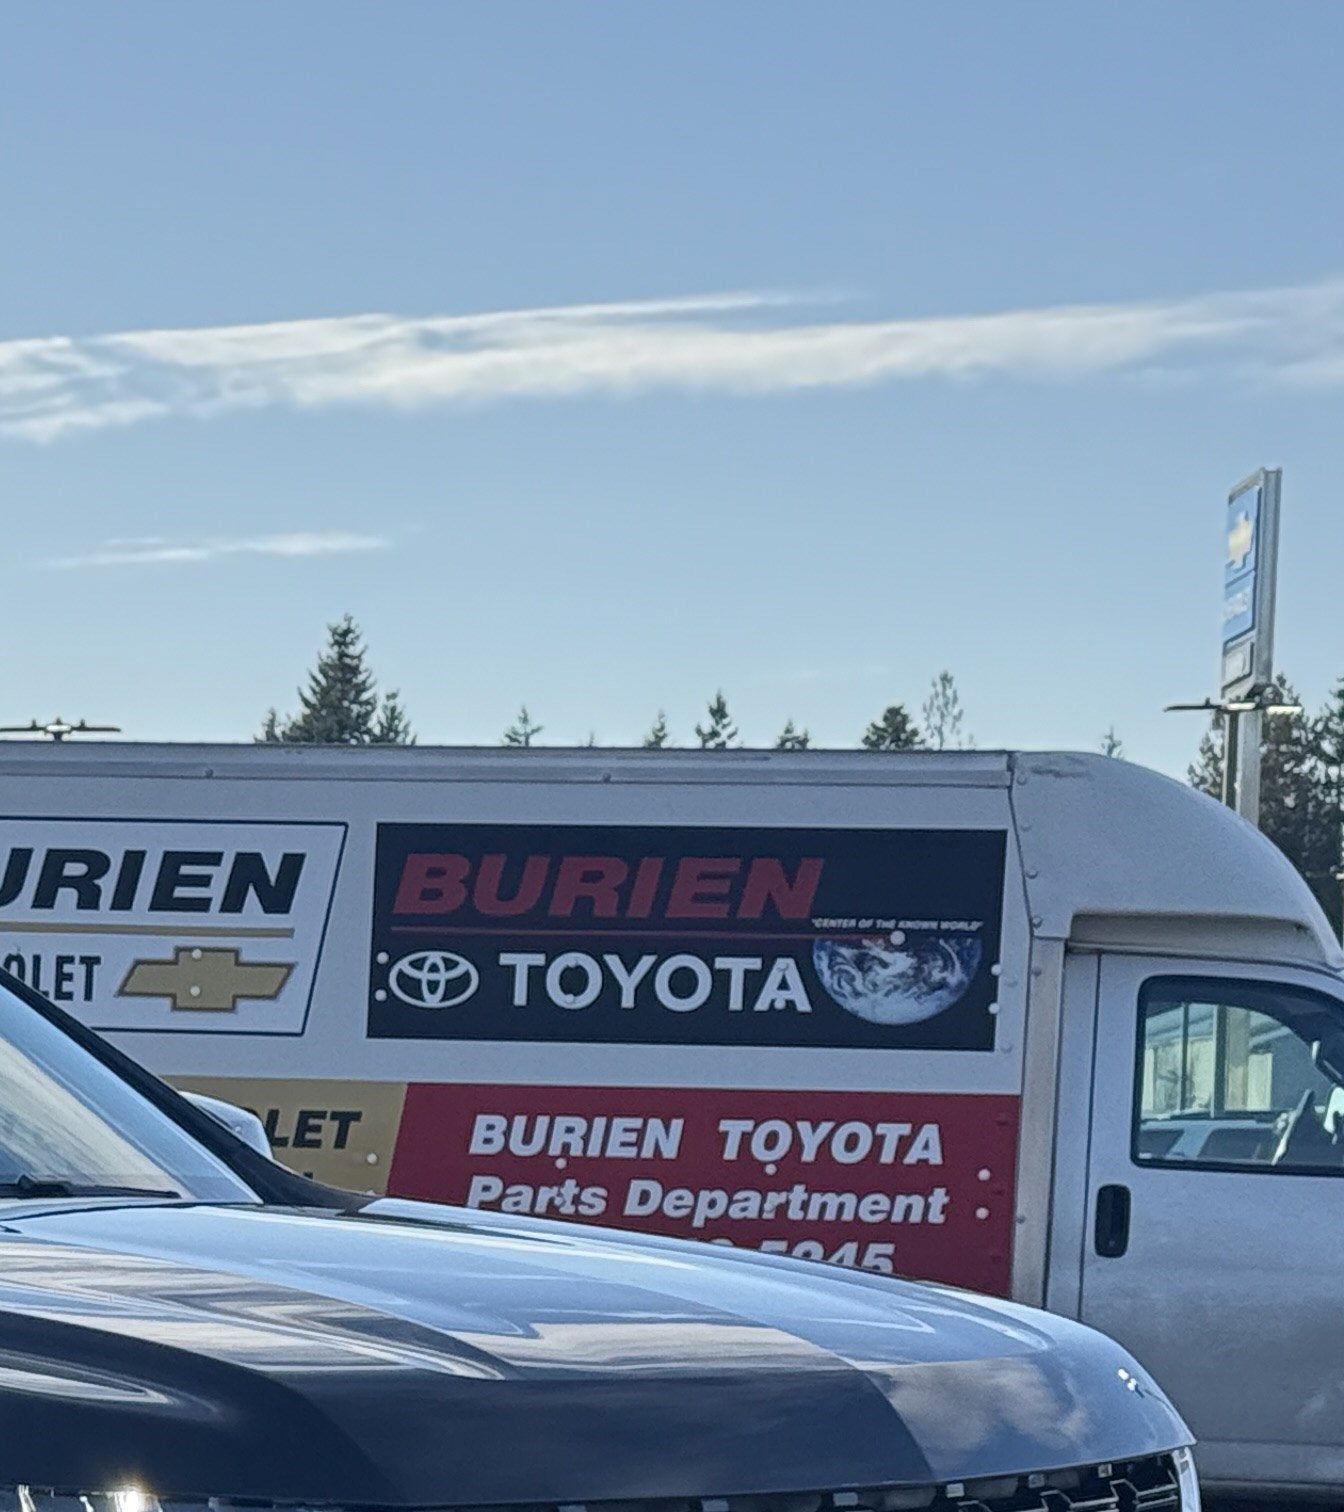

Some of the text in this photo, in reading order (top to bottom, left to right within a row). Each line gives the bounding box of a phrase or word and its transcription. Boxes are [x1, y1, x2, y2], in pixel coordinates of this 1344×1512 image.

[390, 852, 826, 922] BURIEN
[858, 918, 874, 929] OF
[875, 919, 897, 930] THE
[500, 953, 812, 1016] TOYOTA
[468, 1113, 944, 1165] BURIEN TOYOTA
[466, 1175, 951, 1228] Parts Department
